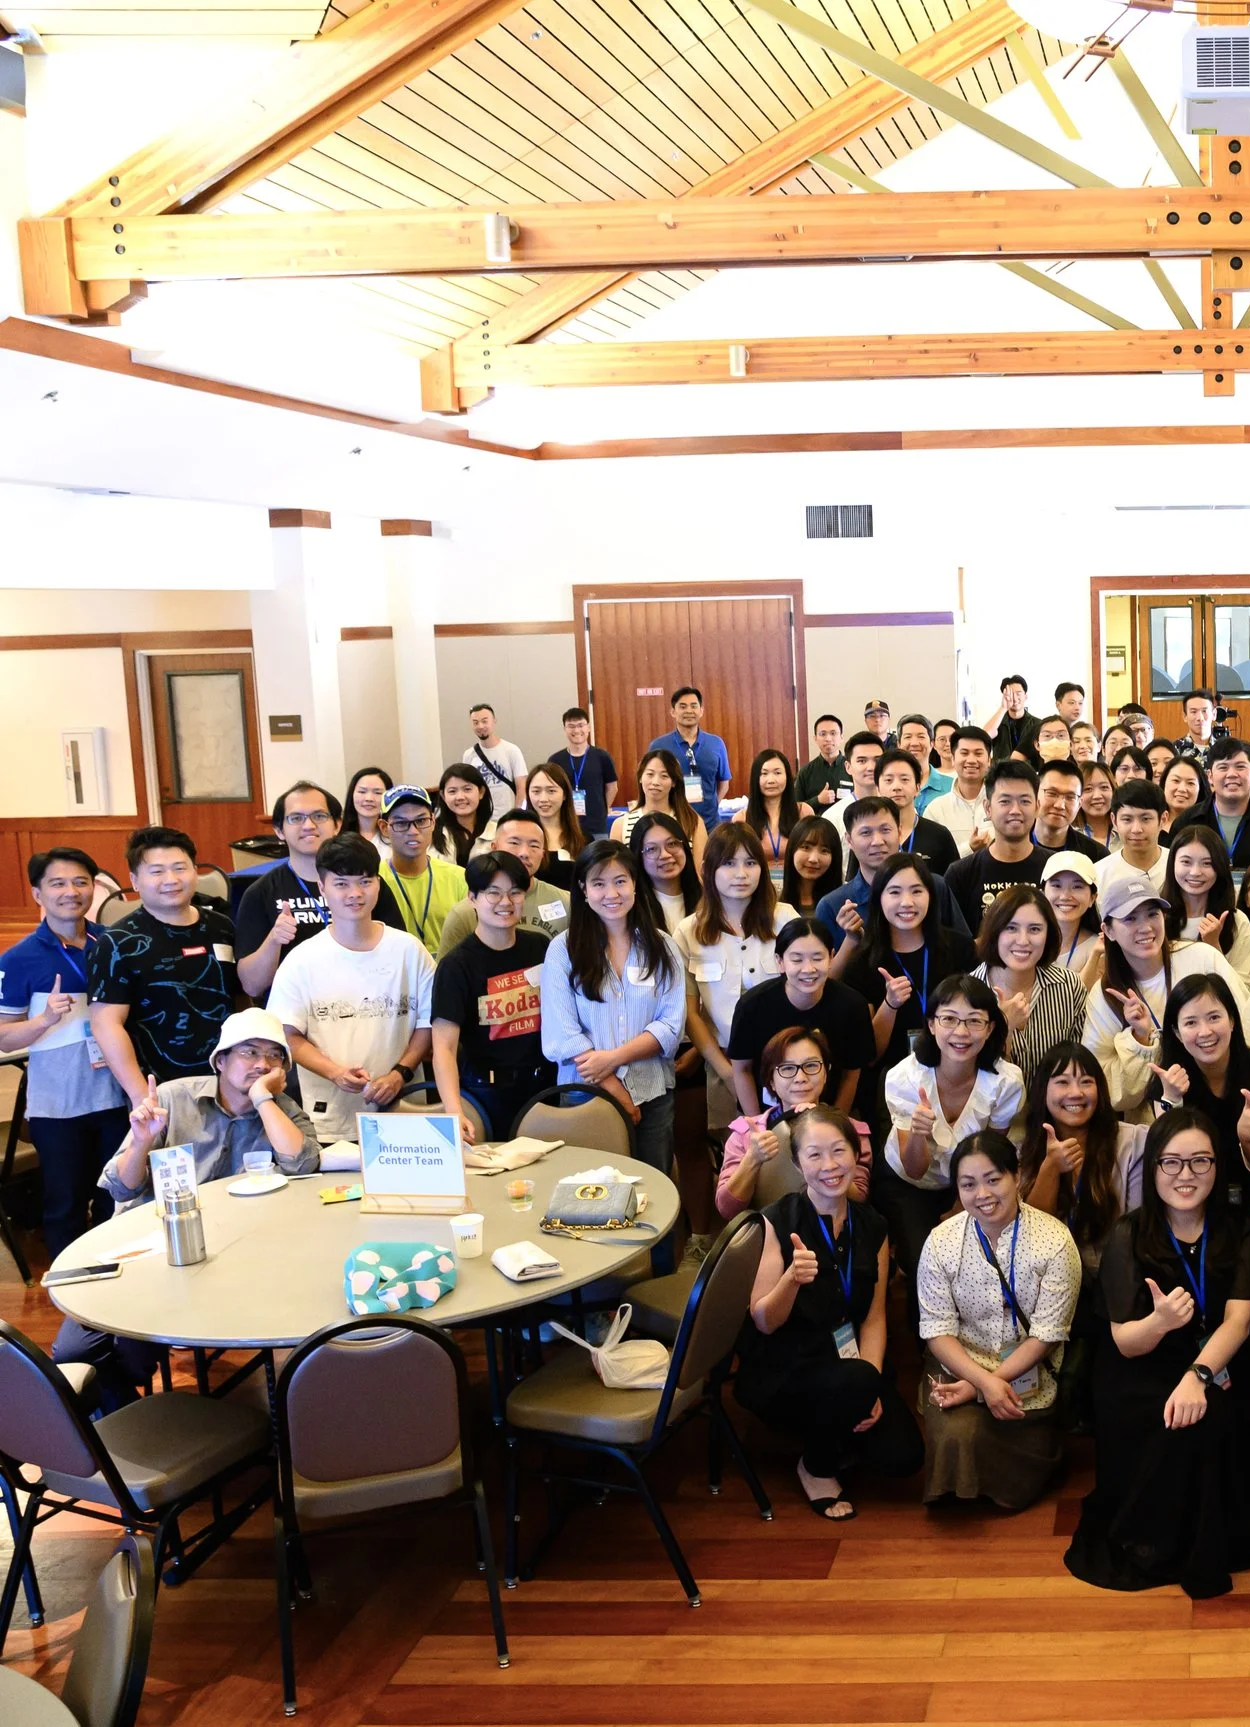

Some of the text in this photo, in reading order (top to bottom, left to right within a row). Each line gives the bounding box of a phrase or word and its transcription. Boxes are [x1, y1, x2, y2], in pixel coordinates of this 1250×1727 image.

[495, 974, 527, 989] WE SE
[509, 1019, 535, 1032] FILM
[379, 1144, 441, 1154] Information
[378, 1155, 443, 1166] Center Team
